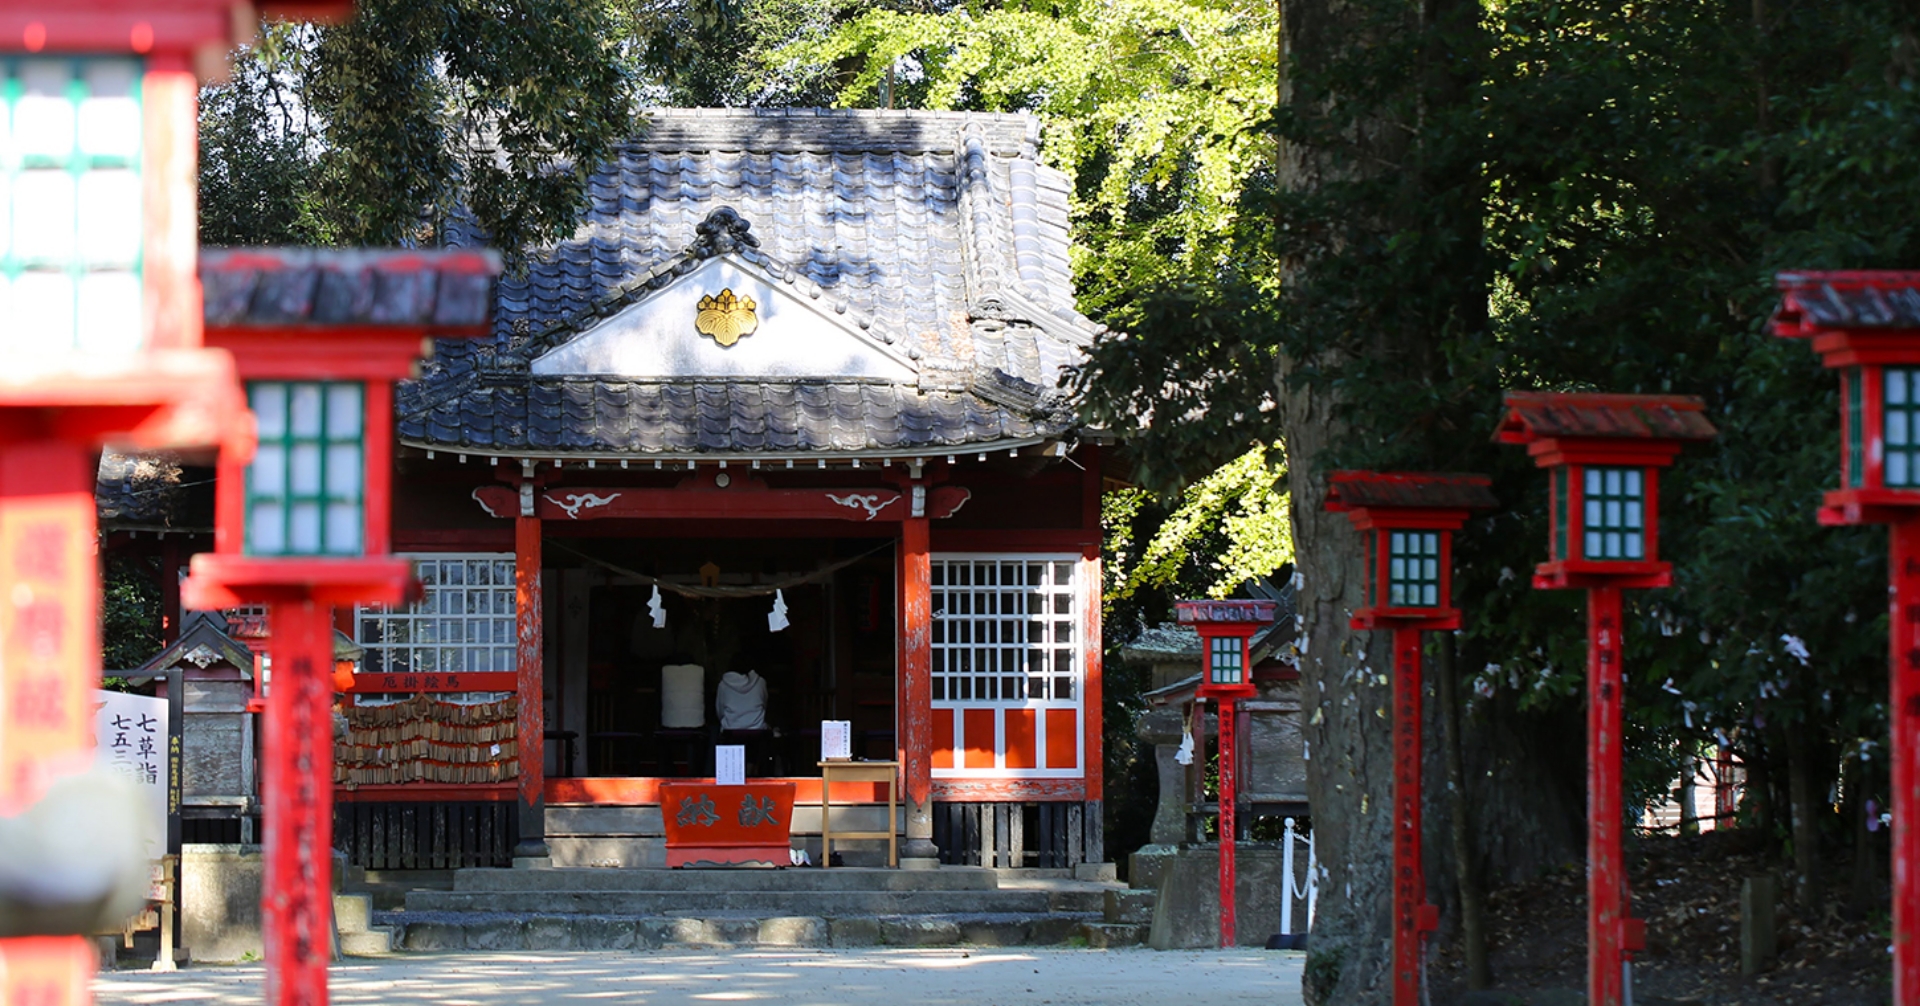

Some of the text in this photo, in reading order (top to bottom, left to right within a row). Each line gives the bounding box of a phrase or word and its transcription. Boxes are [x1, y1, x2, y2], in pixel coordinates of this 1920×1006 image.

[382, 675, 459, 689] 厄掛絵馬
[135, 713, 158, 785] 七草詣
